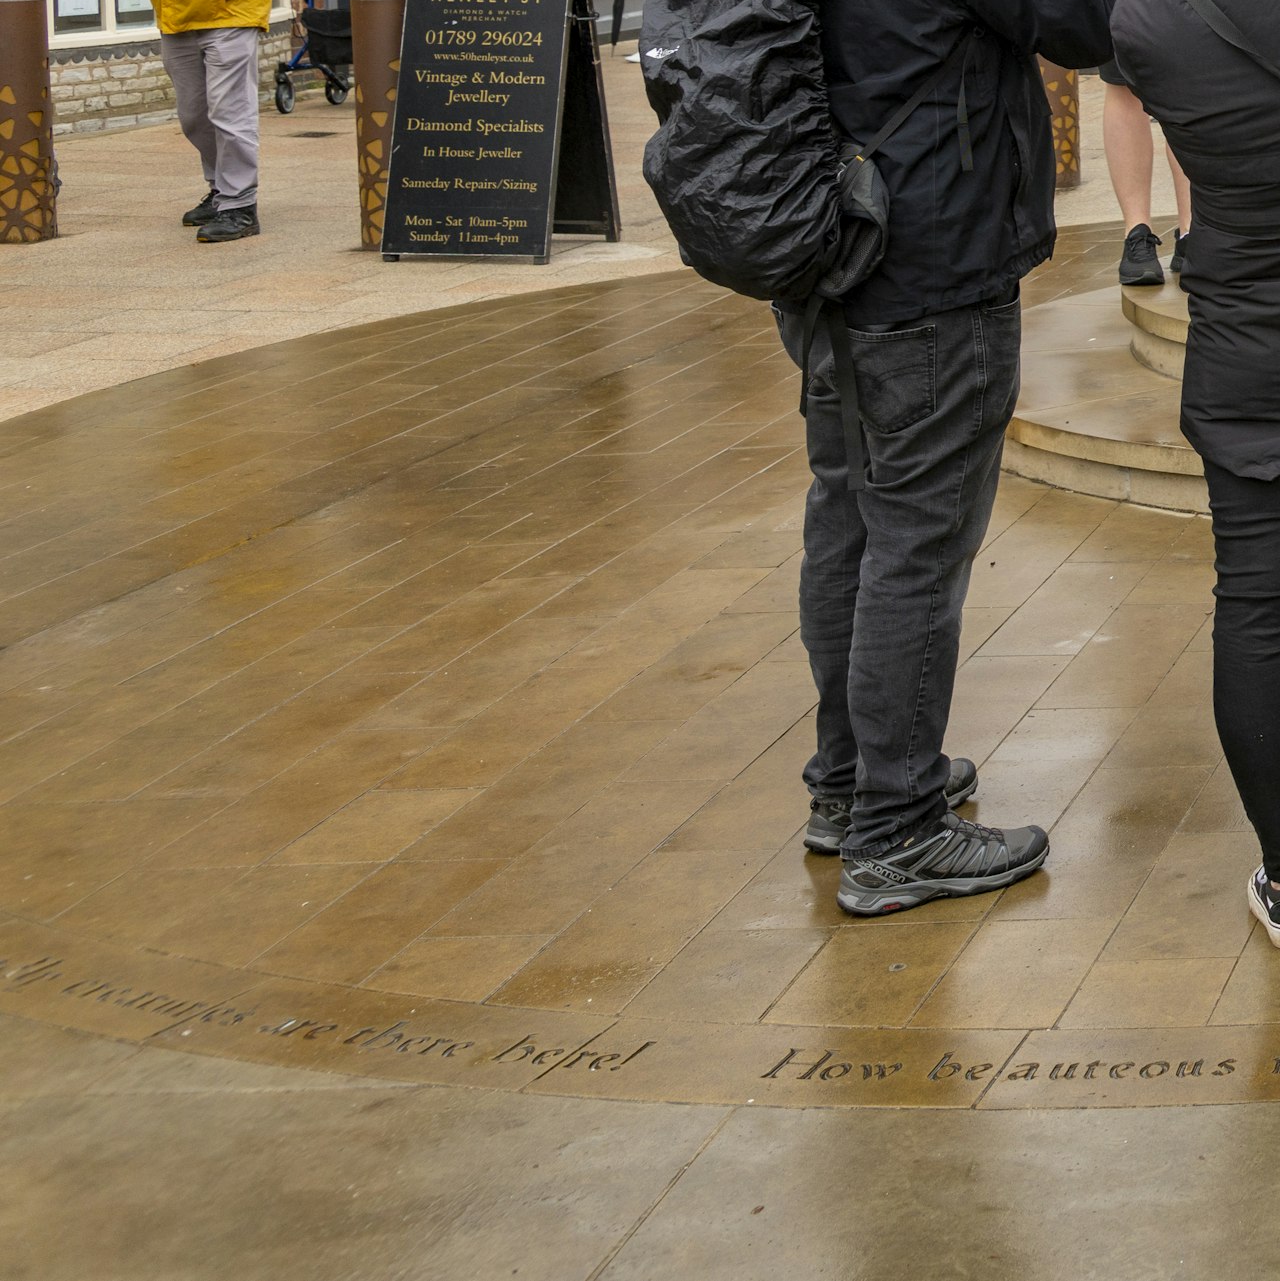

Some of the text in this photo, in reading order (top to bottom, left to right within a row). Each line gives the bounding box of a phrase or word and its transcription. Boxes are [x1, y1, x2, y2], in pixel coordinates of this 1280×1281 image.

[425, 29, 543, 47] 01789 296024
[434, 51, 534, 64] www.50henleyst.co.uk
[415, 70, 545, 87] Vintage & Modern
[445, 89, 510, 106] Jewellery
[406, 118, 544, 135] Diamond Specialists
[423, 146, 523, 161] In House Jeweller
[402, 177, 538, 192] Sameday Repairs/Sizing
[404, 215, 432, 226] Mon
[445, 216, 463, 227] Sat
[469, 216, 528, 230] 10am-5pm
[409, 231, 520, 245] Sunday 11am-4pm
[342, 1020, 476, 1058] there
[759, 1046, 904, 1082] How
[926, 1050, 1240, 1083] beauteous
